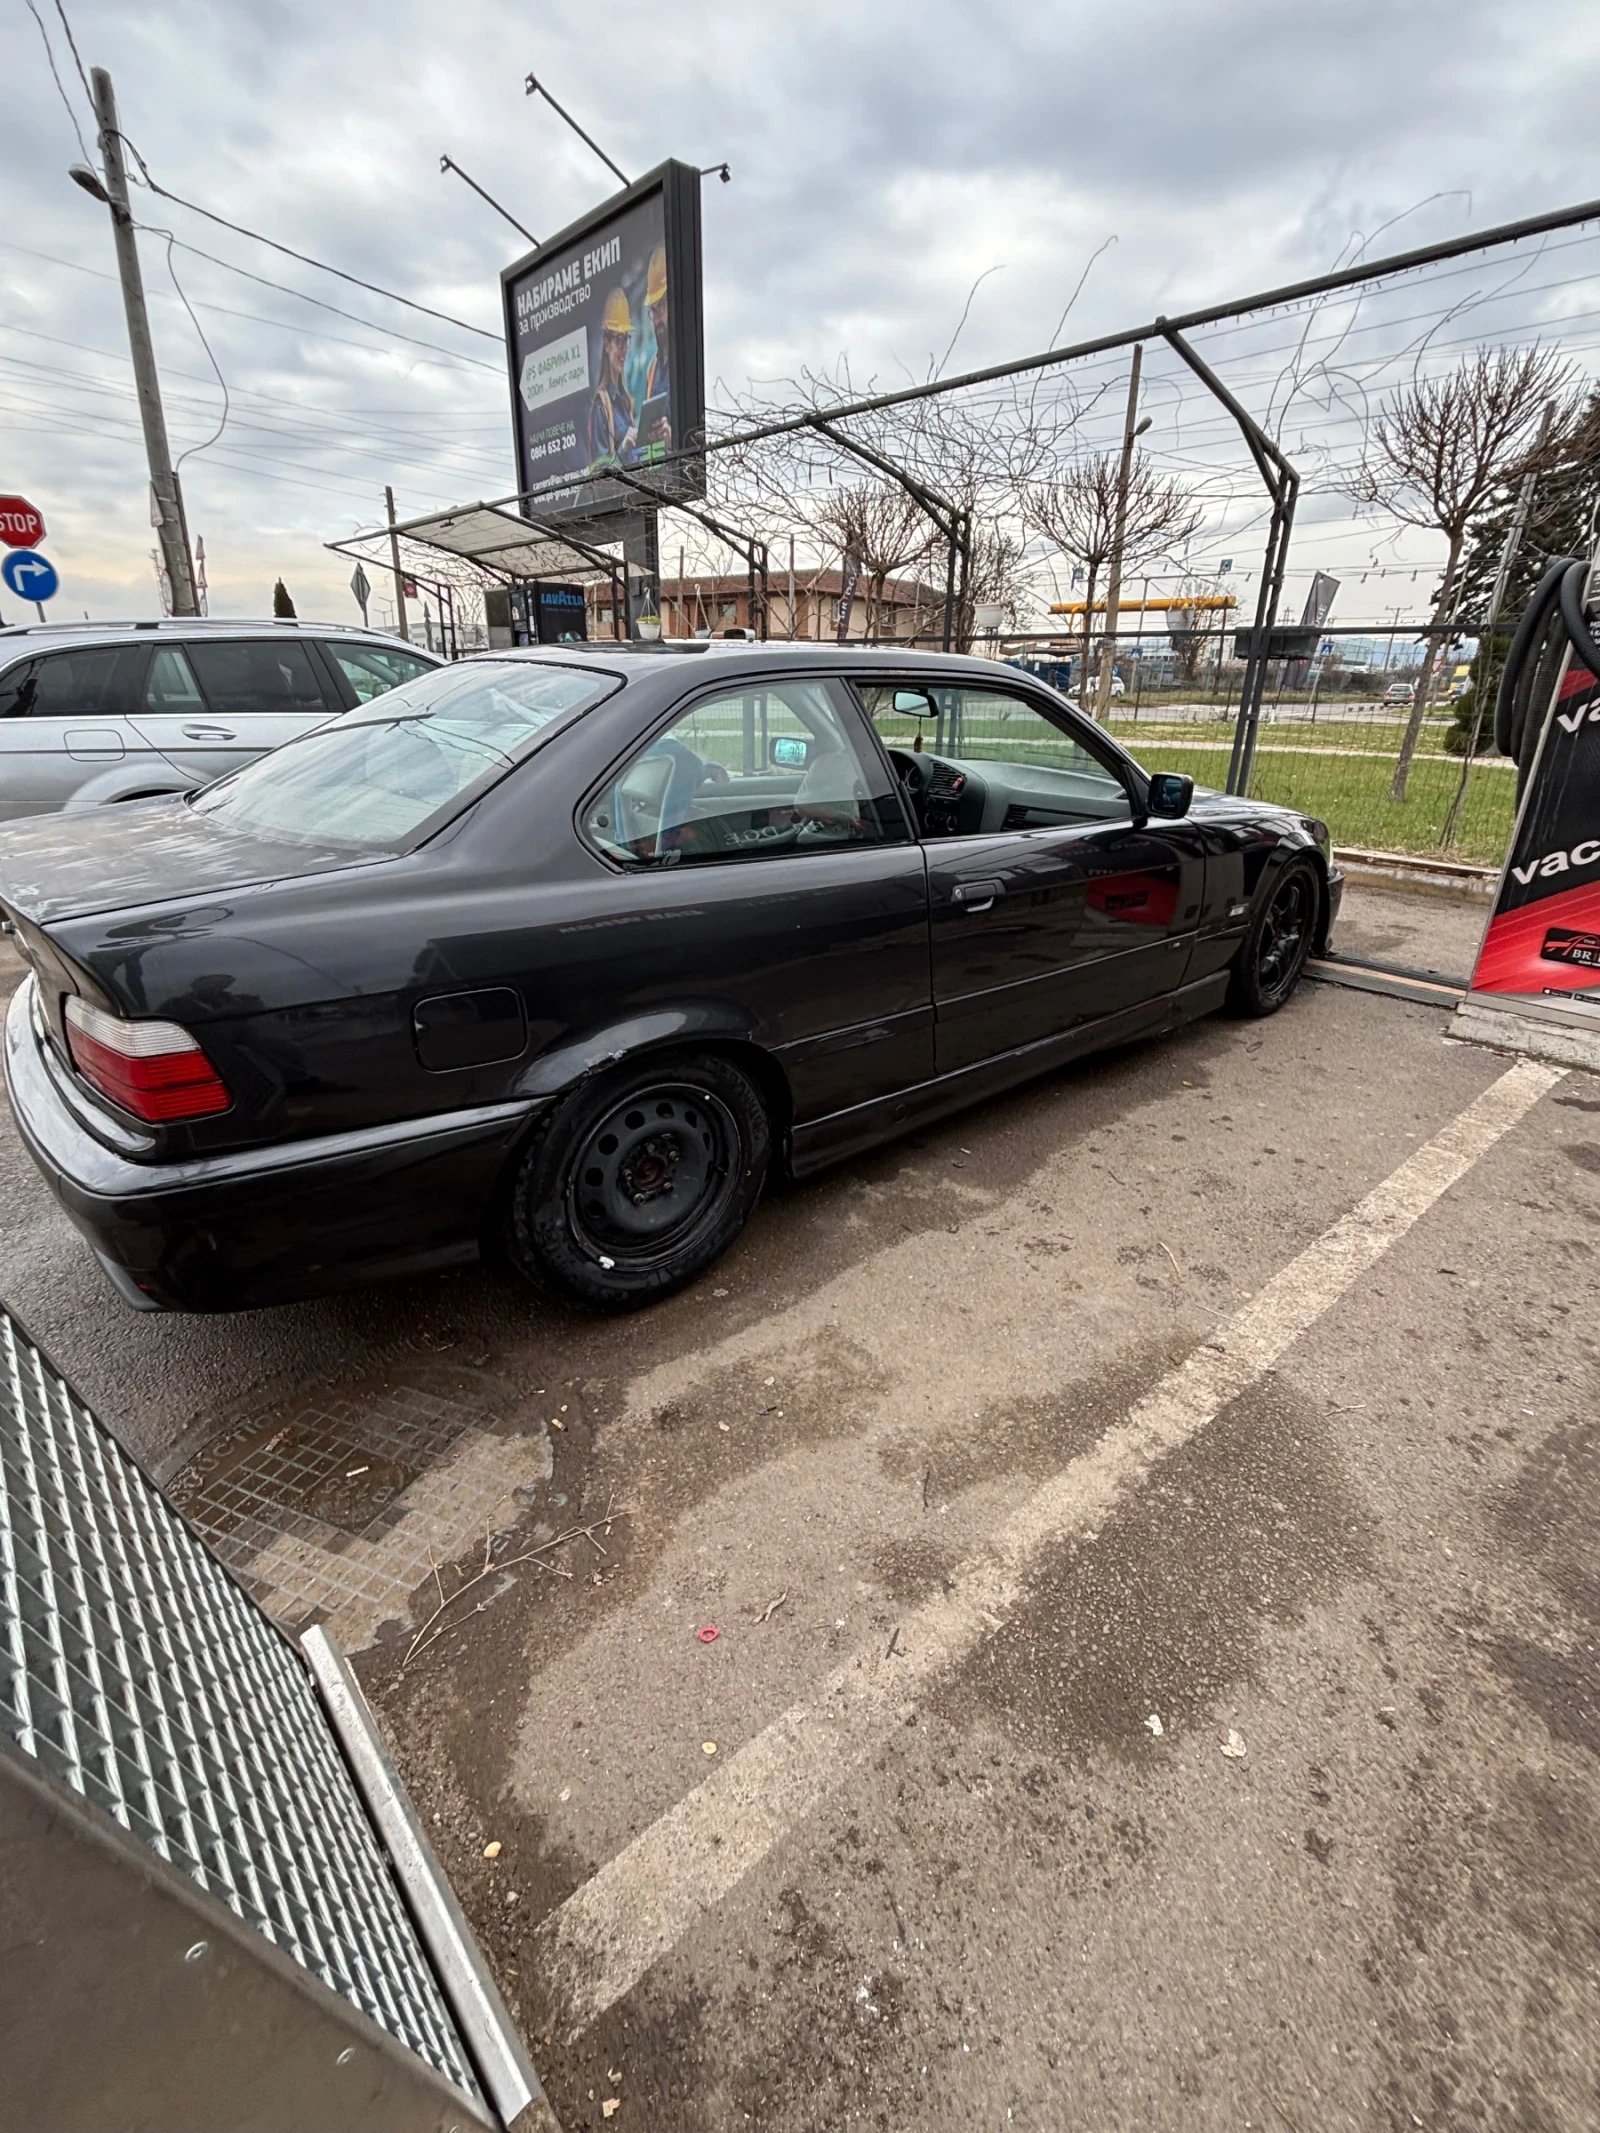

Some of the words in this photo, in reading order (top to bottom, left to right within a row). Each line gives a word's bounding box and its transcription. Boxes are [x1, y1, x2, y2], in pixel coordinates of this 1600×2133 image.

[517, 260, 581, 317] НАБИРАМЕ
[584, 236, 620, 280] ЕКИП
[519, 318, 529, 335] за
[530, 284, 591, 331] производство
[547, 438, 561, 455] 652
[562, 433, 576, 449] 200
[541, 590, 584, 606] LAVAZZA
